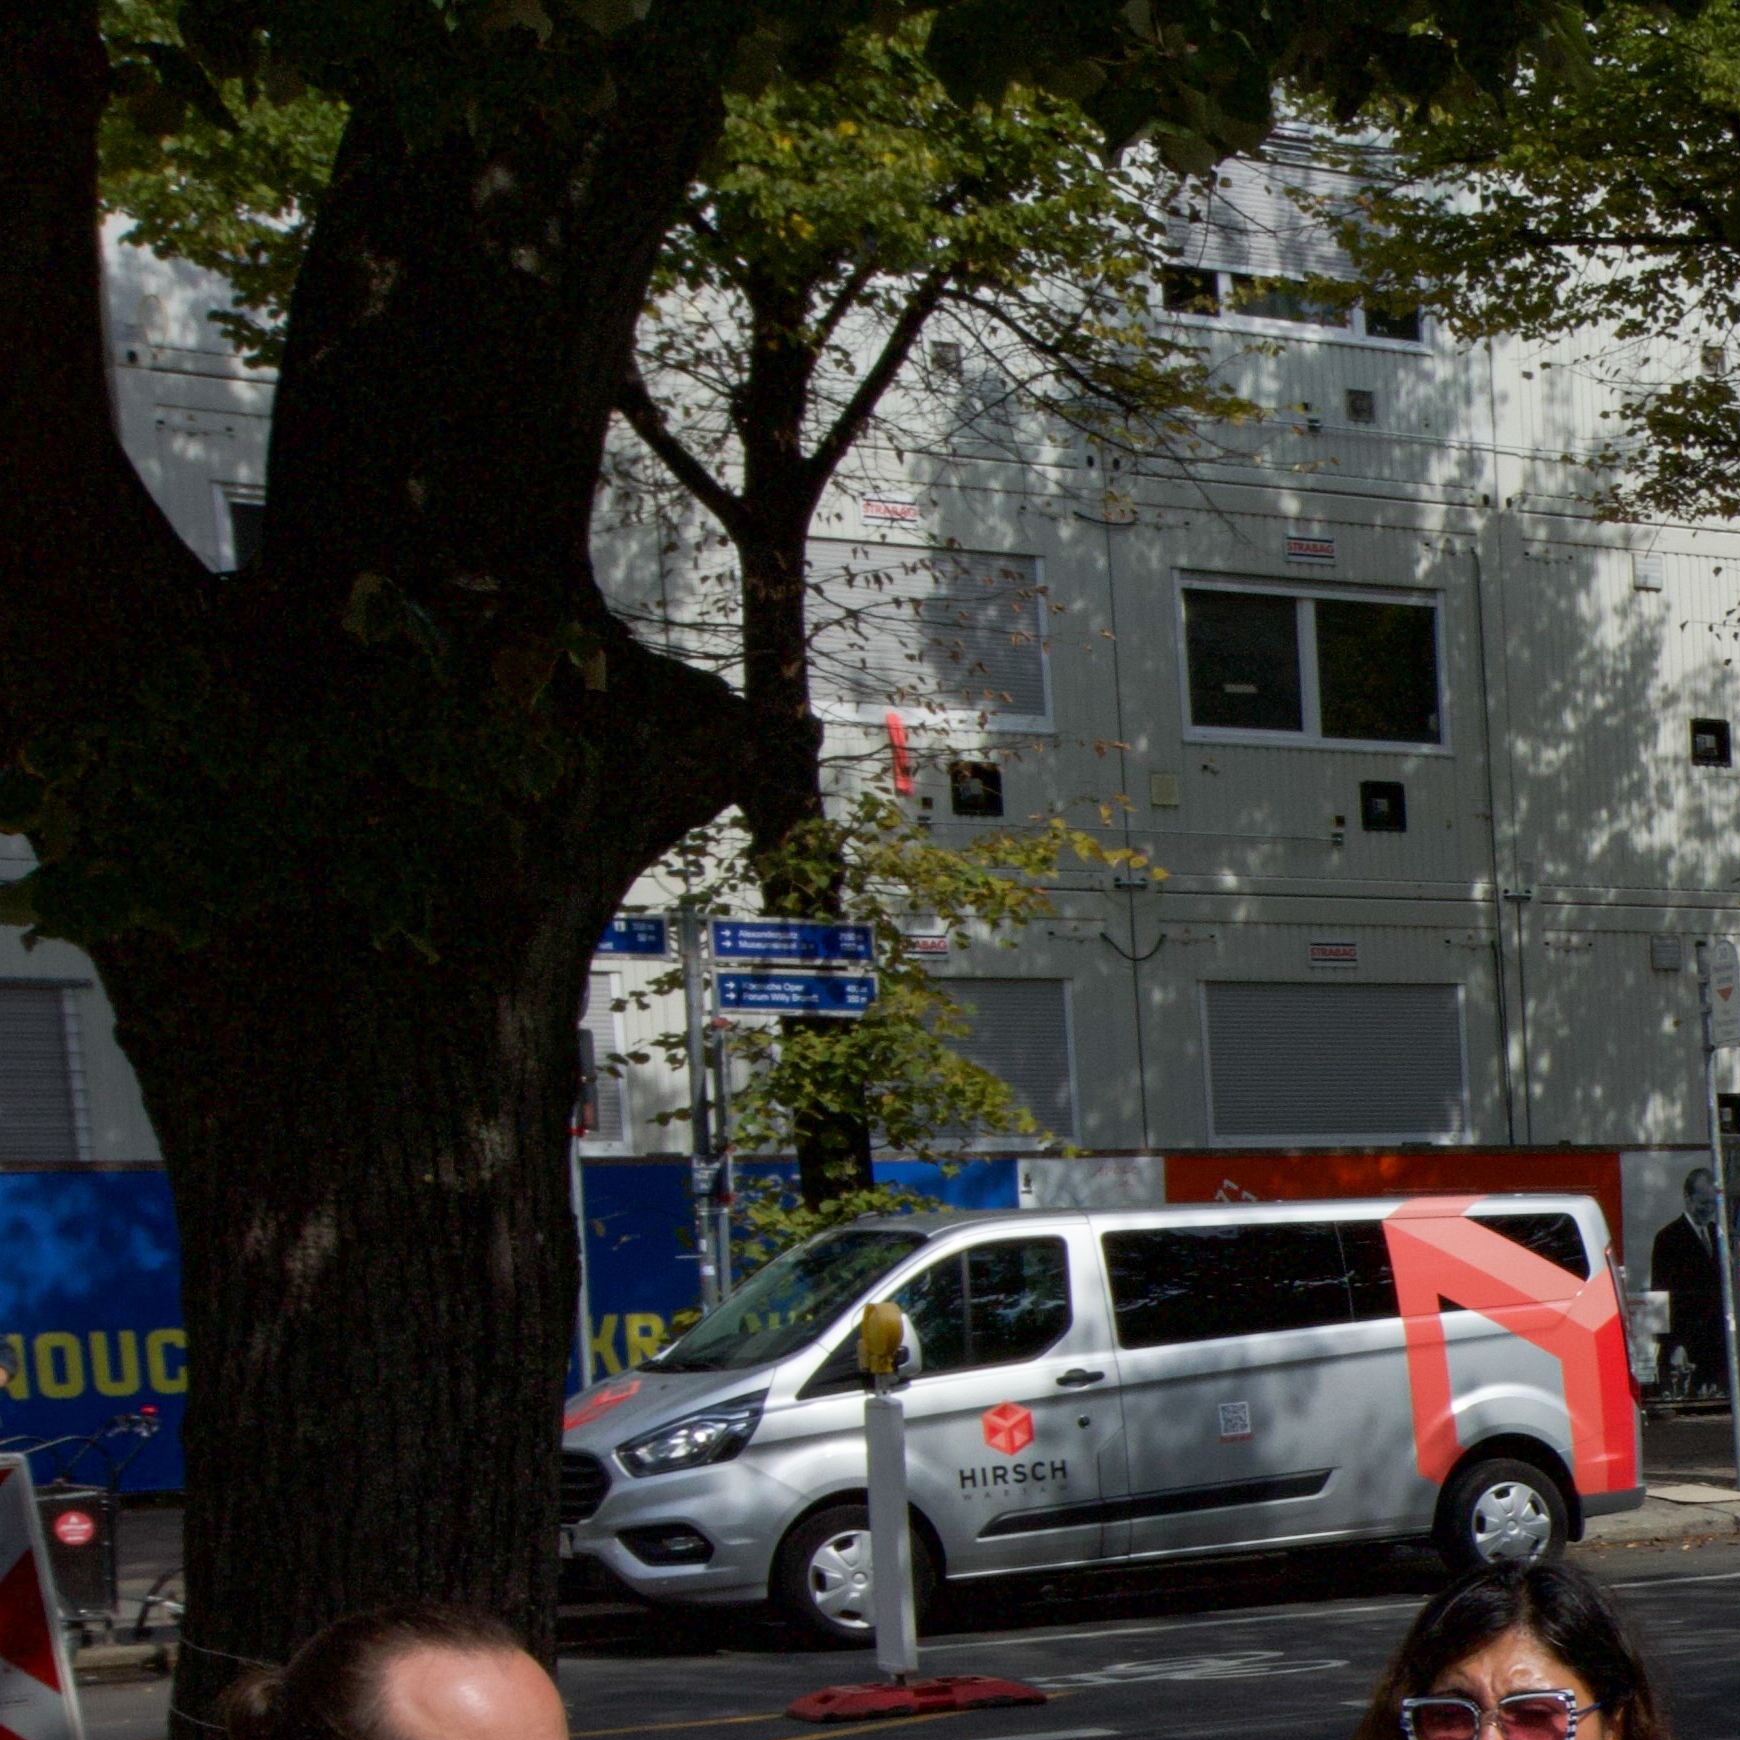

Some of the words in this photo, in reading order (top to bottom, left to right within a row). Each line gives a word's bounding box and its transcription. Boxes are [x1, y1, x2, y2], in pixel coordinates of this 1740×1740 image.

[1286, 540, 1335, 555] STRABAG
[1310, 946, 1357, 959] STRABAG
[958, 1459, 1068, 1490] HIRSCH
